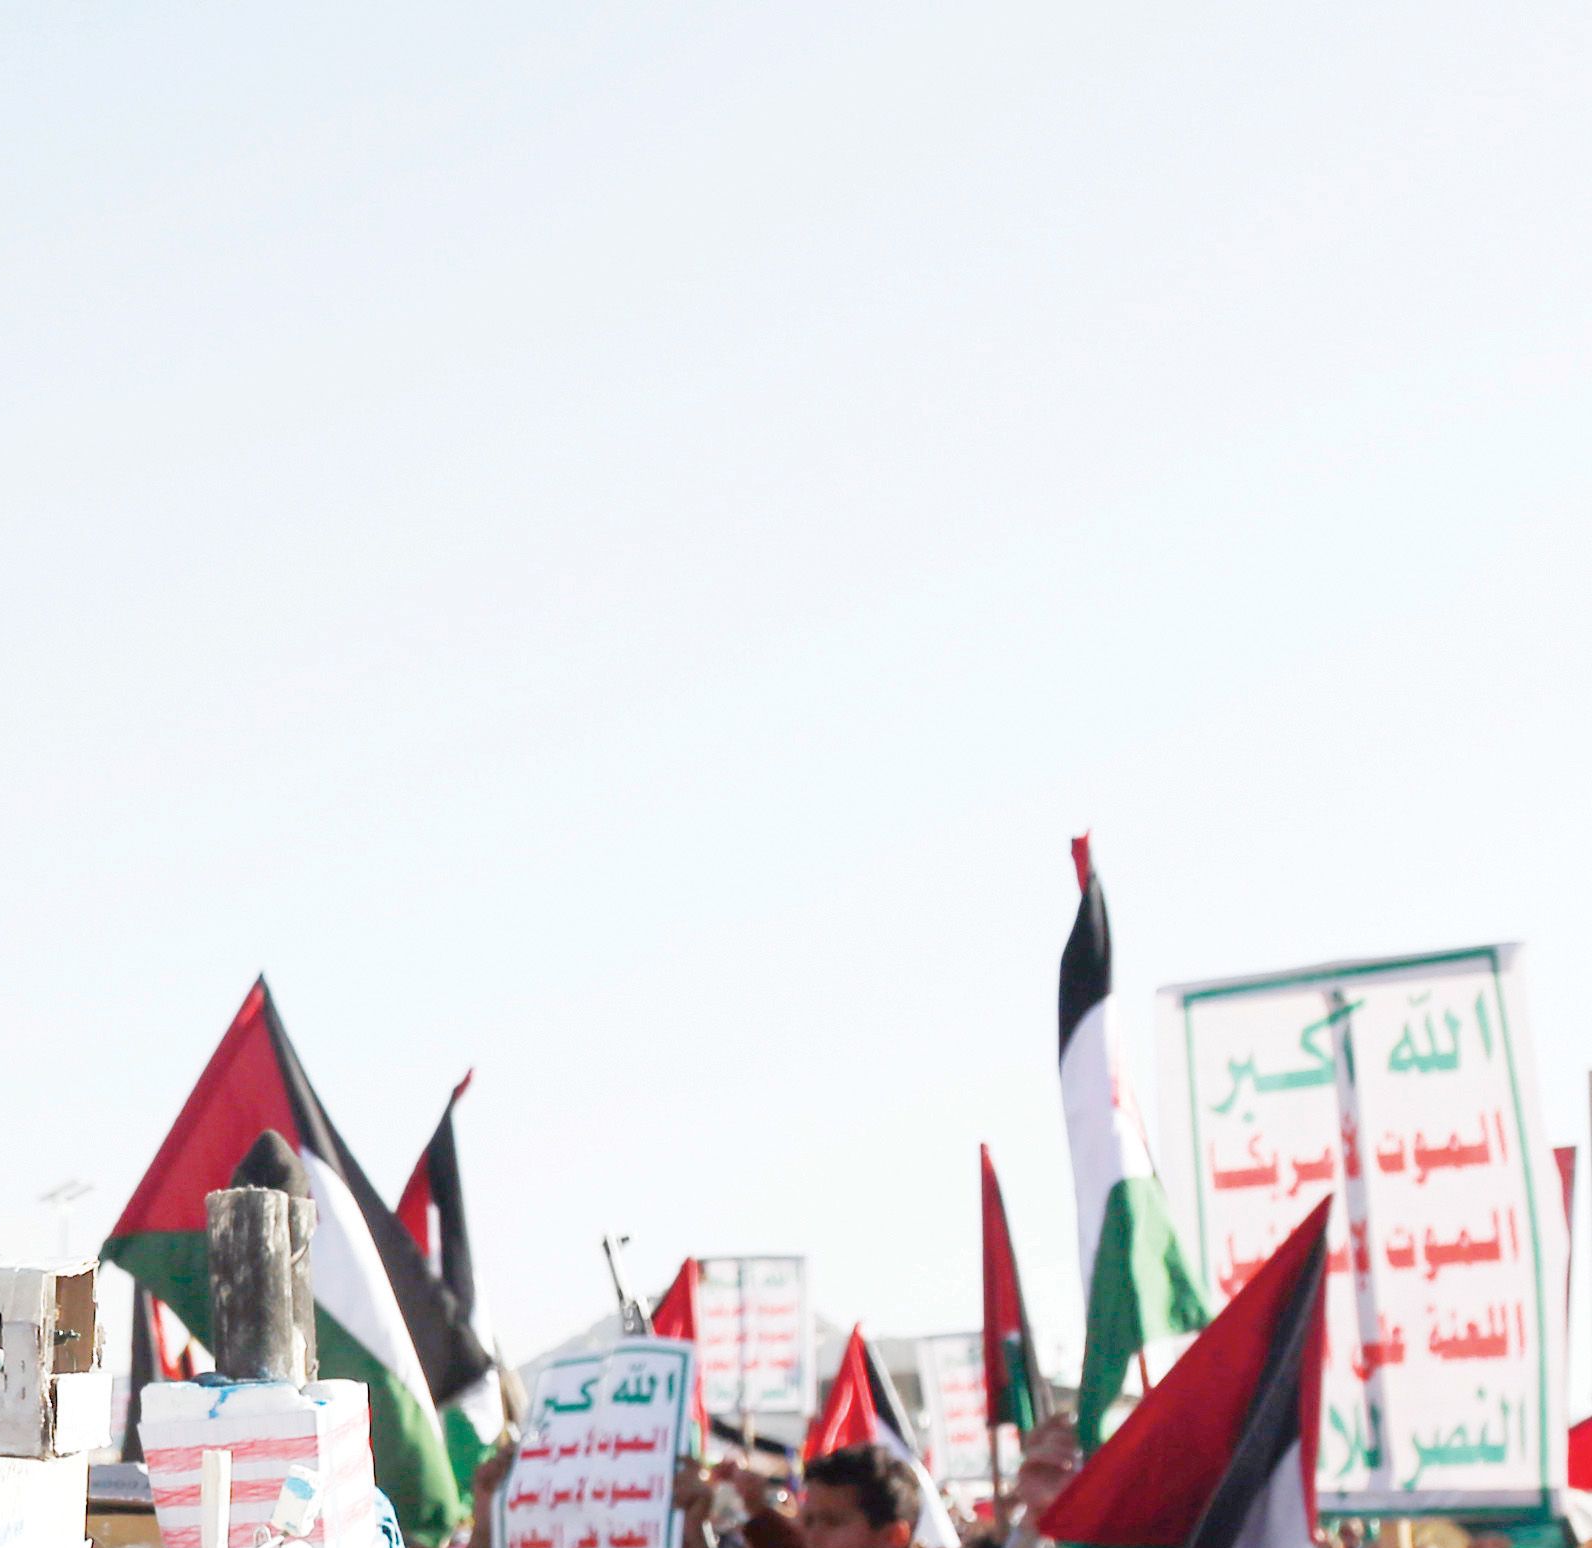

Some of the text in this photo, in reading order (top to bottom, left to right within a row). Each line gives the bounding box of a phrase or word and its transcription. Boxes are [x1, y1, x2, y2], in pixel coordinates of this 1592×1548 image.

[1376, 1110, 1508, 1185] الموت
[1386, 1208, 1518, 1282] الموت
[1428, 1303, 1527, 1363] اللعنة
[1403, 1388, 1528, 1493] النصر
